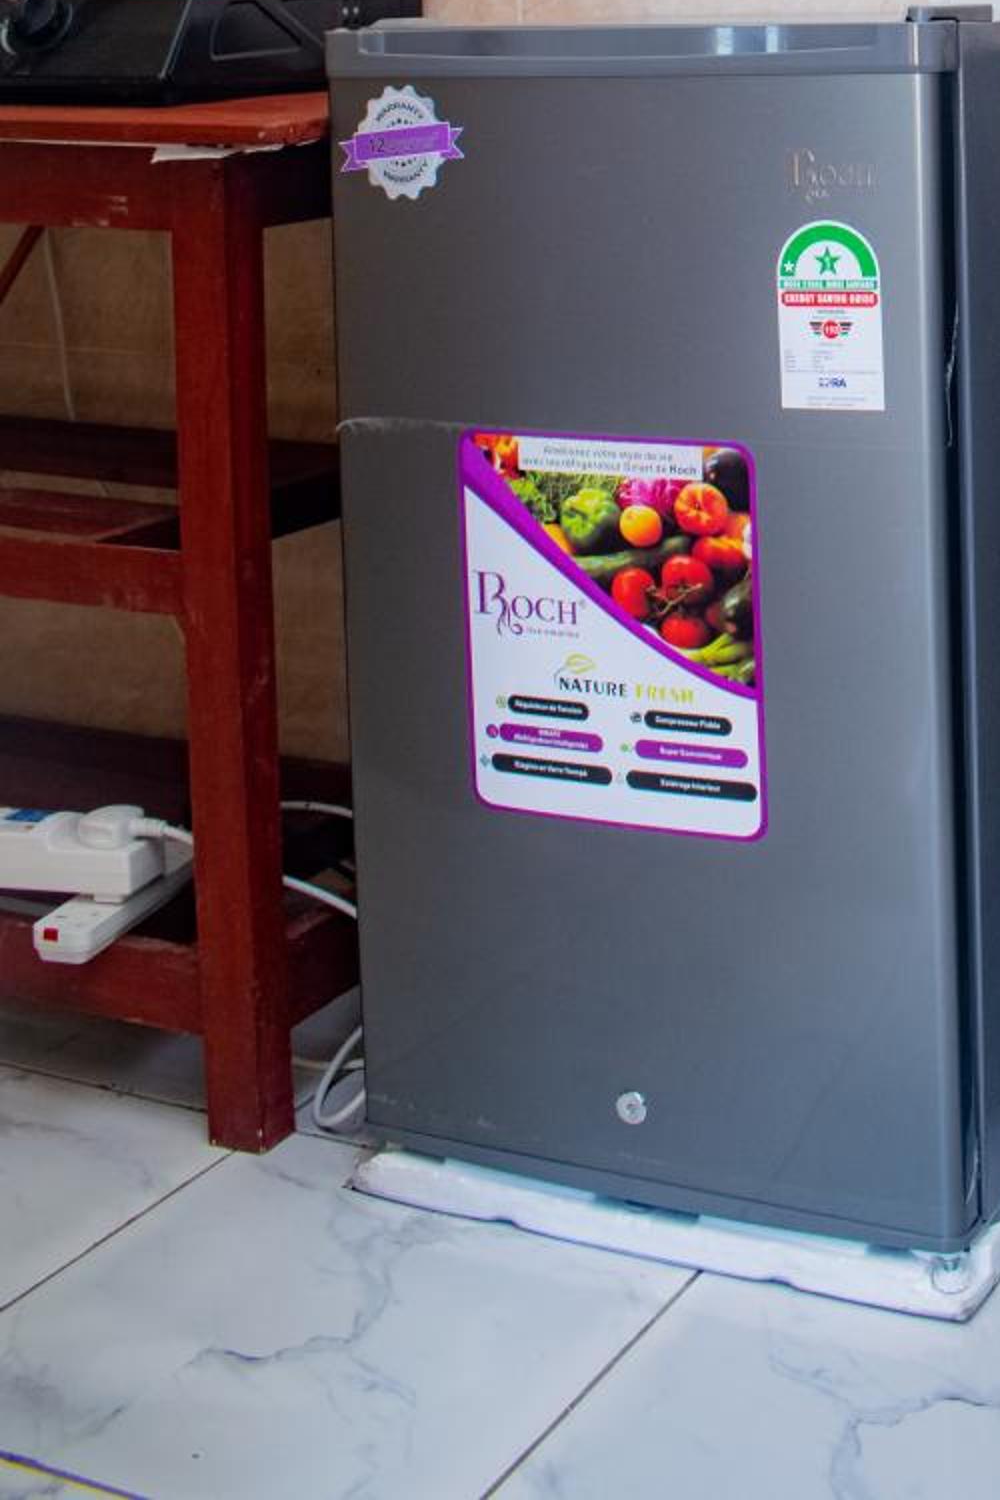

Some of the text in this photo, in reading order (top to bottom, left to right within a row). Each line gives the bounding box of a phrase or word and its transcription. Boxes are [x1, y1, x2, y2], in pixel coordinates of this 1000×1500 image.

[369, 138, 385, 153] 12
[472, 570, 577, 635] ROCH
[559, 677, 694, 702] NATURE FRESH
